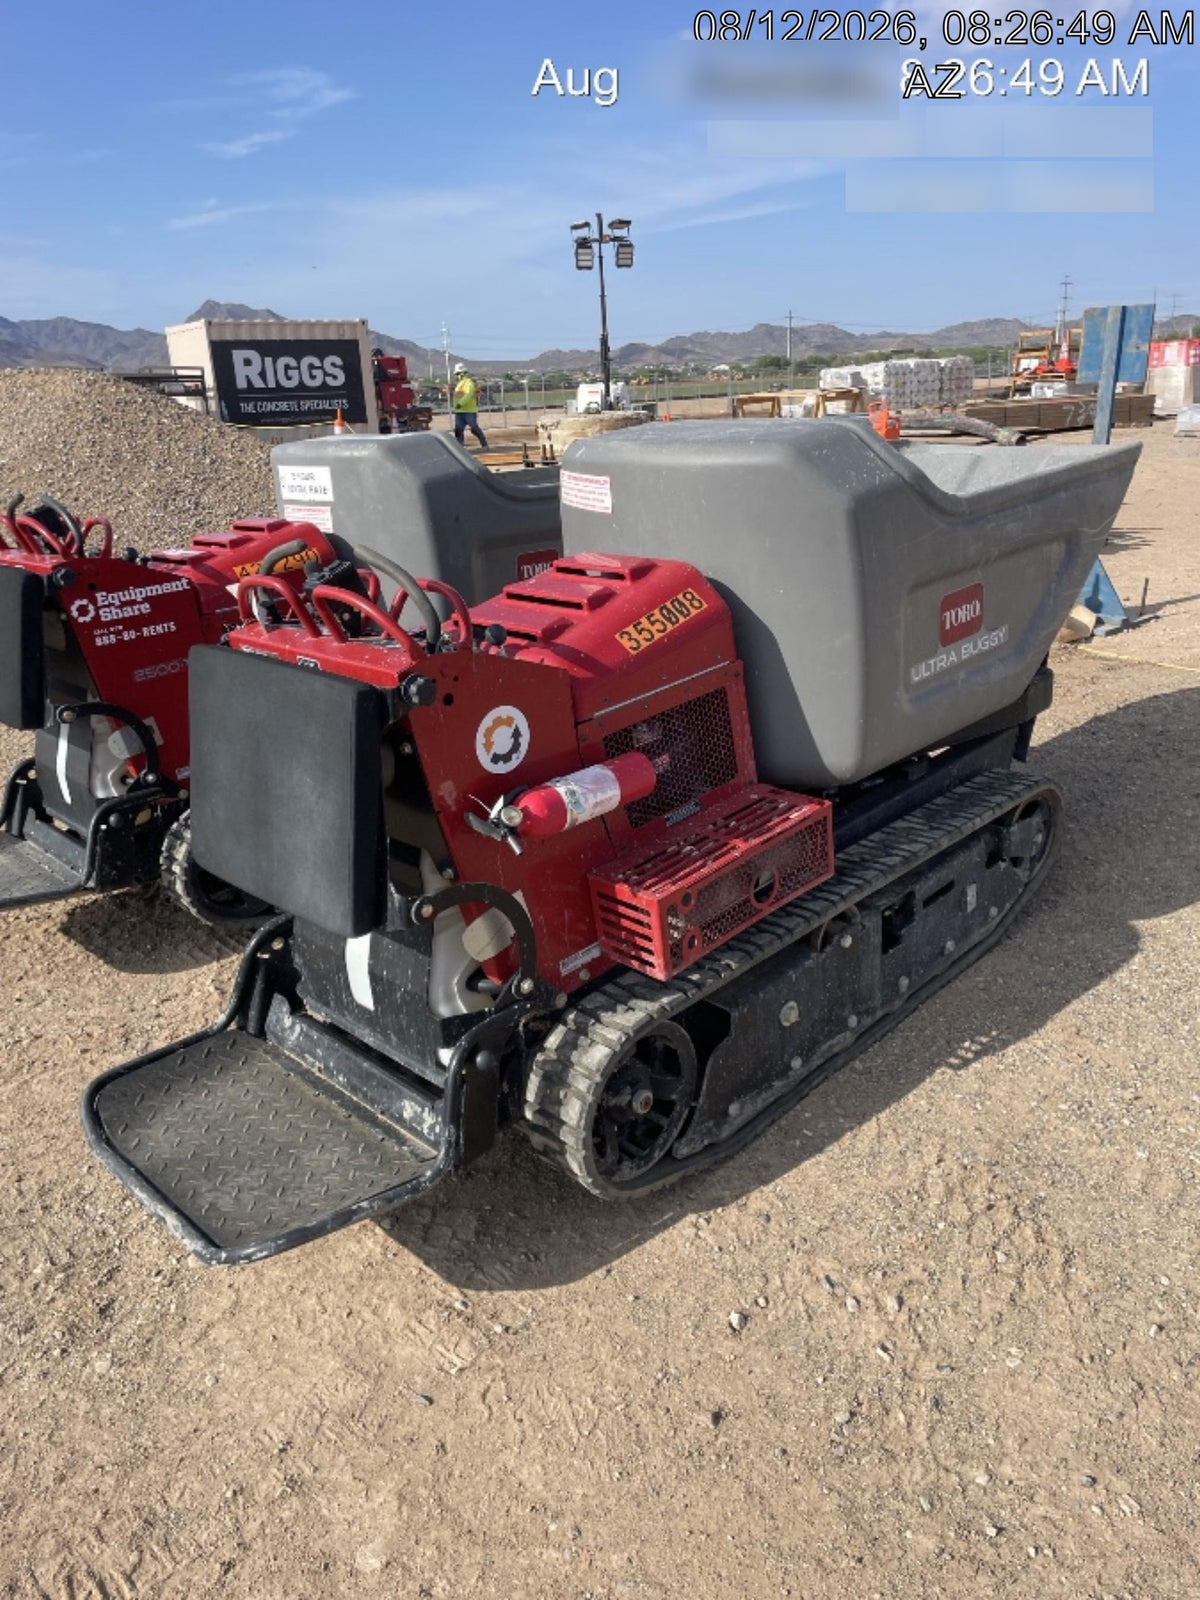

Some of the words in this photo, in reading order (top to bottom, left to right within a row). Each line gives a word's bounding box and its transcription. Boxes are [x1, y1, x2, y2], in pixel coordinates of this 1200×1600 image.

[232, 349, 346, 389] RIGGS
[240, 402, 256, 414] THE
[256, 401, 299, 412] CONCRETE
[299, 399, 349, 411] SPECIALISTS
[95, 577, 190, 606] Equipment
[99, 602, 151, 622] Share
[618, 590, 704, 652] 355008
[942, 600, 981, 630] TORO
[95, 621, 177, 646] 888-80-RENTS
[910, 650, 957, 684] ULTRA
[961, 624, 1009, 660] BUGGY
